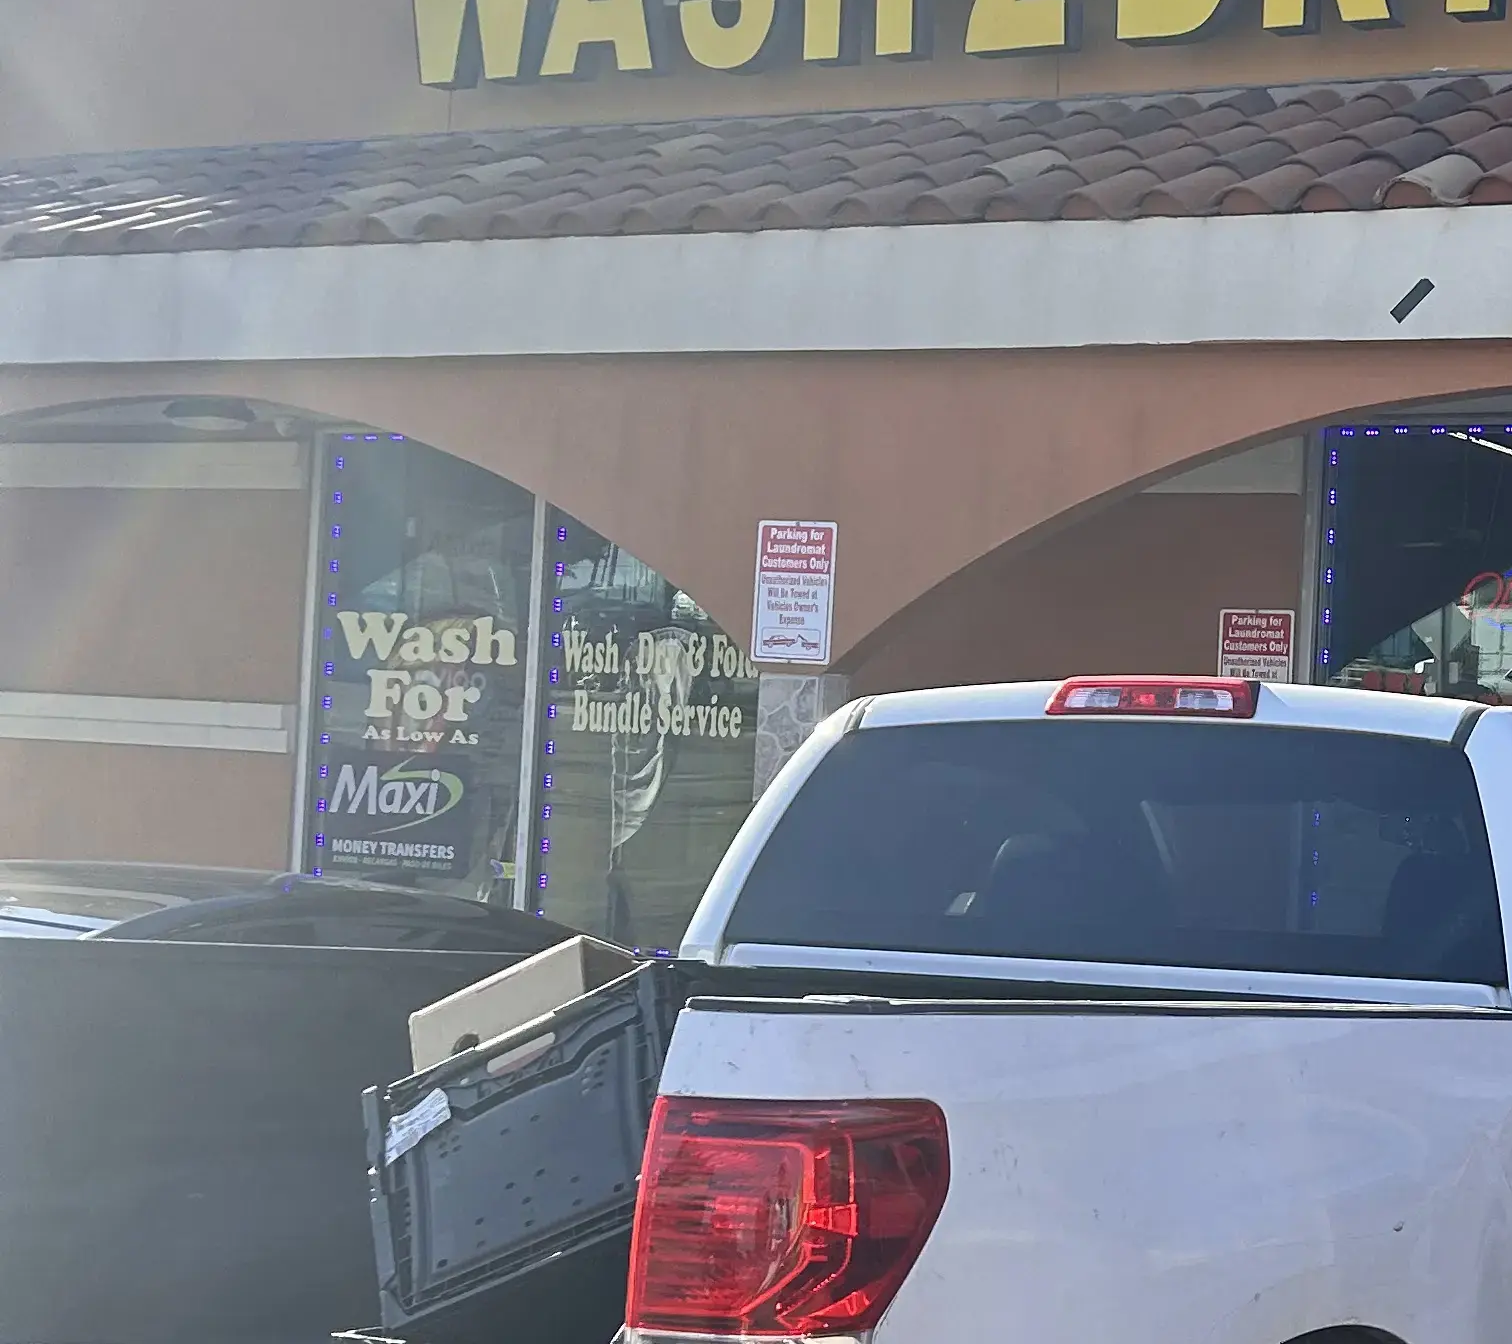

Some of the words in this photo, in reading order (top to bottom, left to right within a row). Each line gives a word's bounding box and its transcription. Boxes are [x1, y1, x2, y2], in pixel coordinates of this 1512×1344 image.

[770, 527, 808, 543] Parking
[810, 529, 825, 541] for
[767, 541, 826, 555] Laundromat
[762, 555, 807, 569] Customers
[809, 557, 830, 573] Only
[1231, 614, 1267, 628] Parking
[1269, 616, 1283, 626] for
[336, 611, 518, 666] Wash
[1228, 627, 1285, 639] Laundromat
[686, 632, 707, 677] &
[1223, 639, 1267, 651] Customers
[1269, 640, 1288, 655] Only
[364, 669, 481, 722] For
[572, 690, 652, 735] Bundle
[656, 693, 743, 739] Service
[362, 725, 391, 741] As
[396, 726, 445, 743] Low
[449, 729, 479, 745] As
[328, 764, 441, 815] Maxi
[332, 839, 378, 855] MONEY
[379, 841, 455, 860] TRANSFERS
